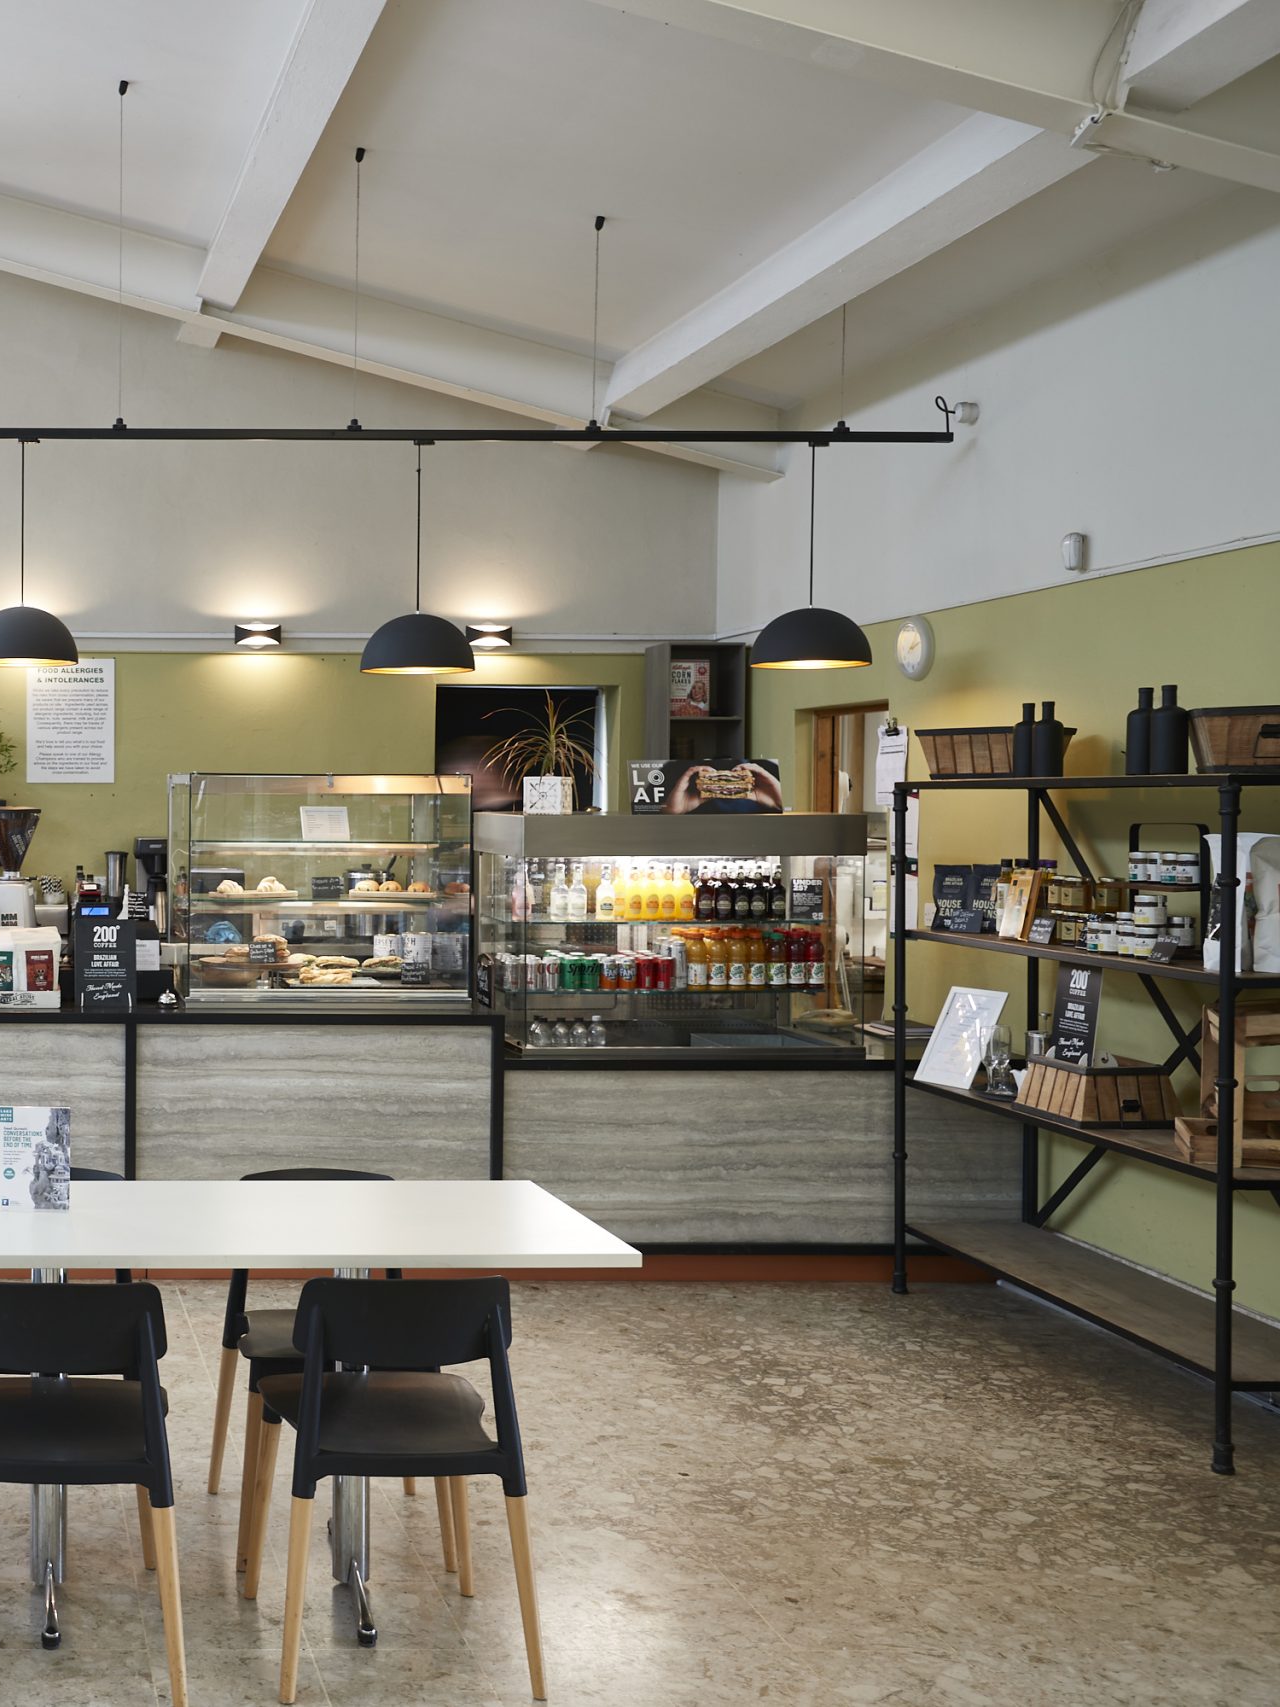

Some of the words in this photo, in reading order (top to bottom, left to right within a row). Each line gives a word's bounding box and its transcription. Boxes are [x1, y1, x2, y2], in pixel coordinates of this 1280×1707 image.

[937, 899, 962, 908] HOUSE
[972, 900, 996, 909] HOUS
[93, 992, 120, 1000] England
